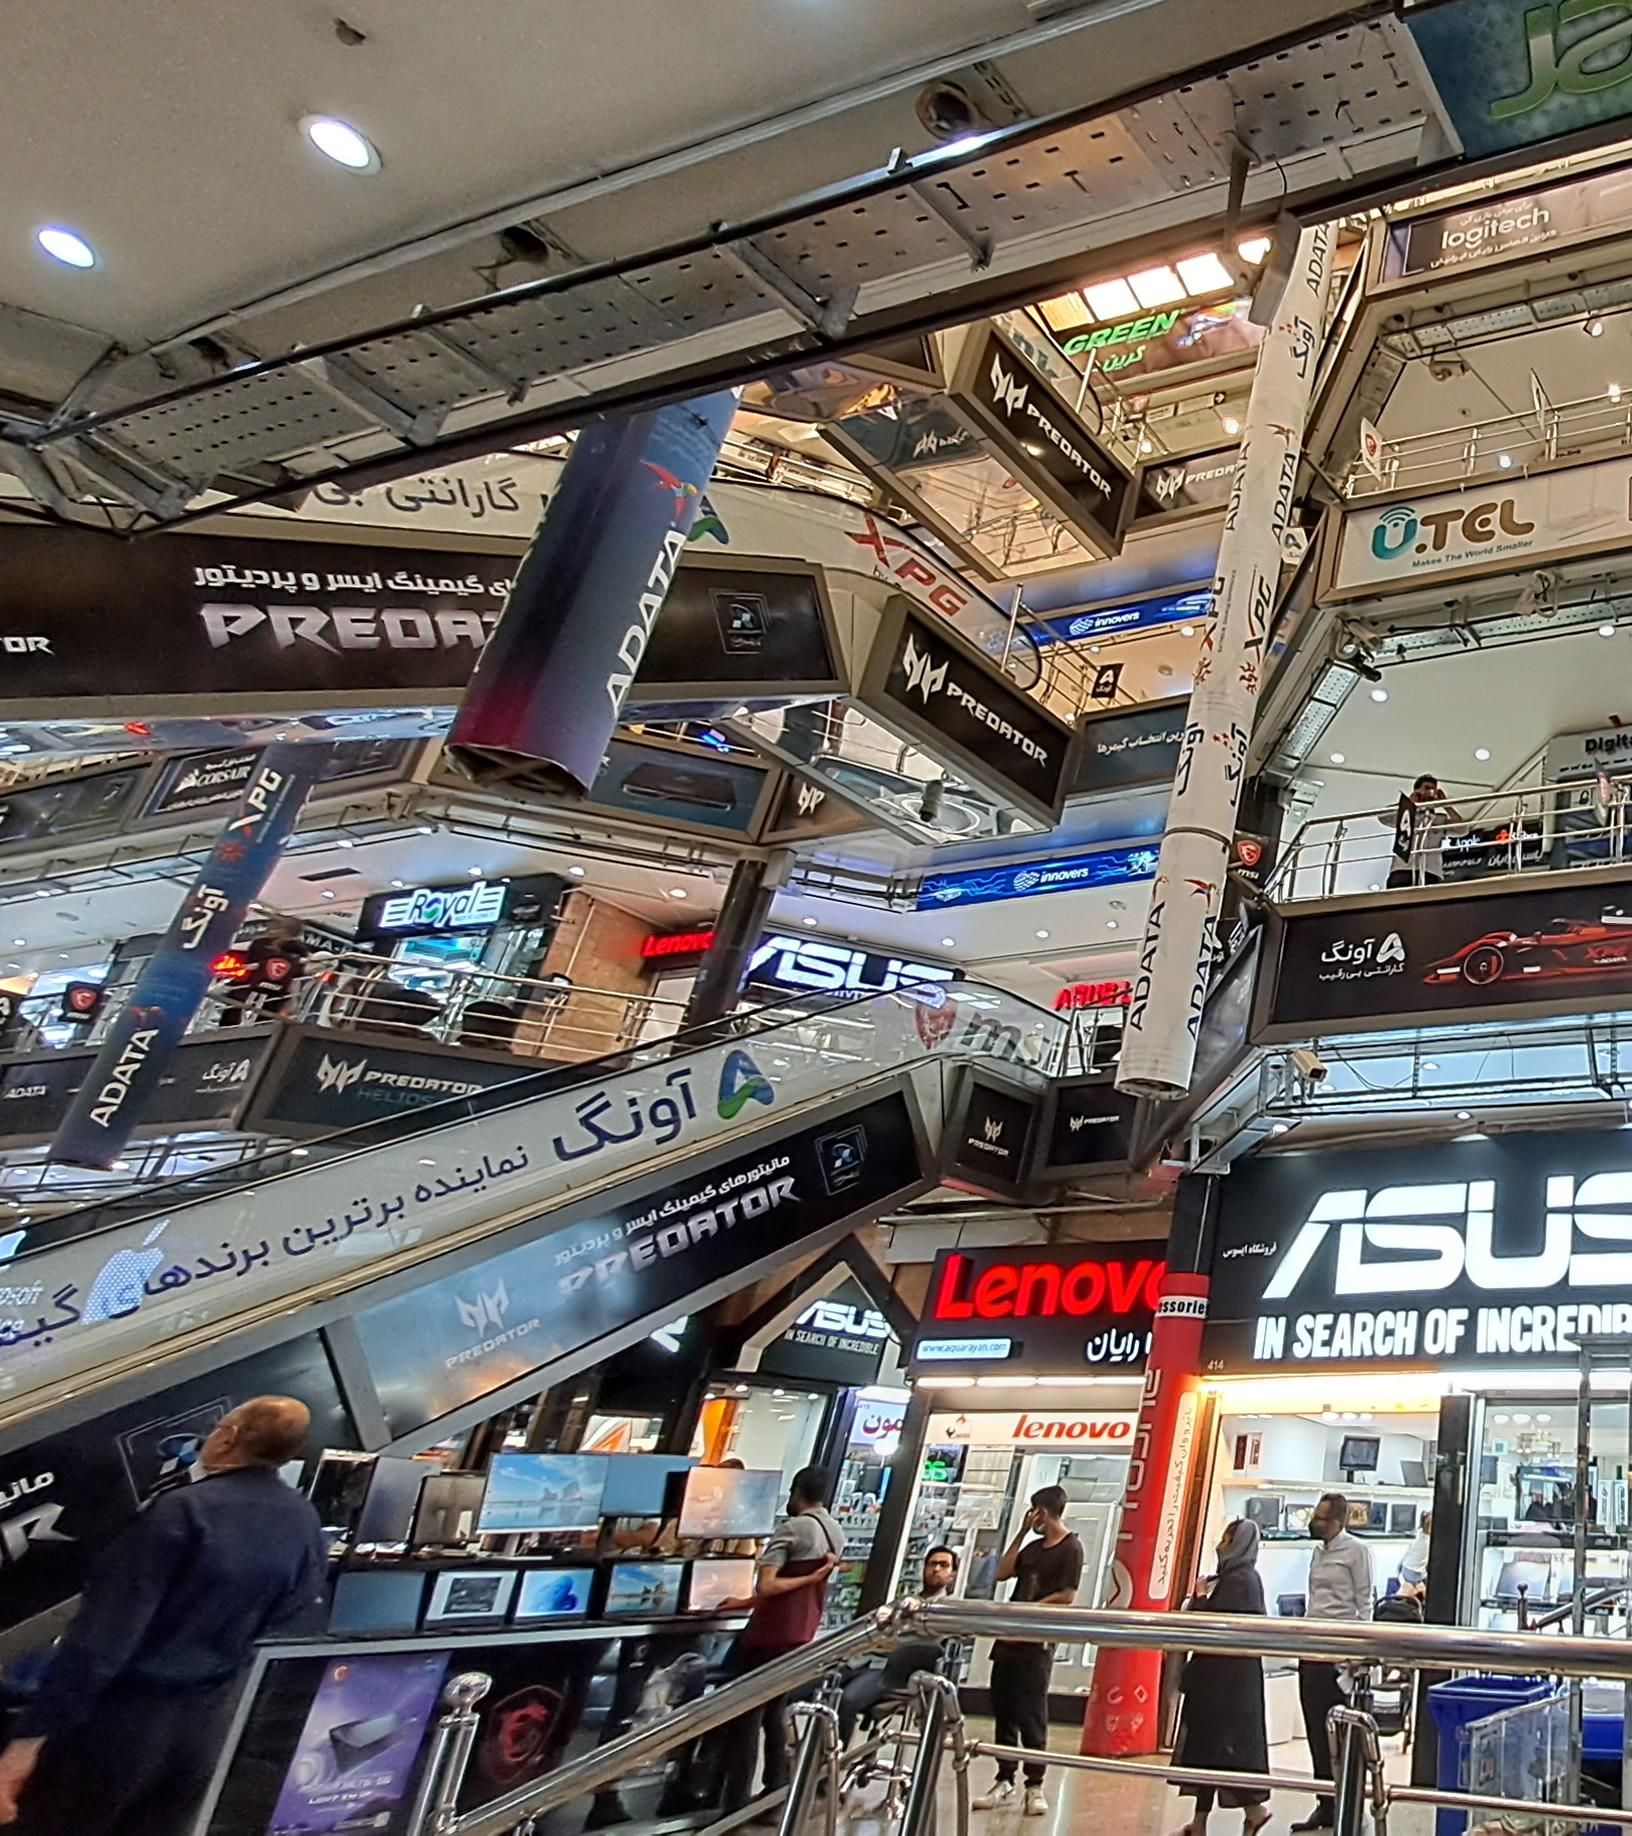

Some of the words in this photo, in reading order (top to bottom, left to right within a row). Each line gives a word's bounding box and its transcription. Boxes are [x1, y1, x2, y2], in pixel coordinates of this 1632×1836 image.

[1441, 207, 1550, 249] logitech
[1062, 309, 1181, 356] GREEN
[1026, 405, 1112, 501] PREDATOR
[386, 477, 520, 518] گارانتی
[1272, 448, 1297, 545] ADATA
[845, 512, 968, 616] XPG
[1412, 558, 1442, 568] Makes
[1445, 554, 1462, 562] The
[1465, 547, 1493, 559] World
[1495, 540, 1533, 553] Smaller
[195, 564, 297, 594] پردیتور
[302, 572, 320, 591] و
[326, 572, 383, 592] ایسر
[387, 573, 484, 597] گیمینگ
[607, 529, 687, 720] ADATA
[1094, 610, 1140, 629] innovers
[946, 685, 1049, 767] PREDATOR
[1455, 834, 1482, 852] Apple
[1041, 866, 1089, 883] innovers
[1238, 868, 1259, 880] msi
[408, 881, 487, 928] Royal
[740, 934, 957, 1008] ASUS
[1130, 901, 1166, 1031] ADATA
[1321, 937, 1377, 965] آونگ
[1362, 962, 1405, 978] گارانتی
[1187, 912, 1217, 1043] ADATA
[90, 1029, 159, 1128] ADATA
[363, 1072, 485, 1095] PREDATOR
[553, 1068, 699, 1162] آونگ
[1084, 1114, 1120, 1124] PREDATOR
[415, 1142, 529, 1203] نماینده
[718, 1155, 790, 1194] مانیتورهای
[659, 1183, 717, 1218] گیمینگ
[281, 1195, 405, 1257] برترین
[557, 1174, 804, 1295] PREDATOR
[625, 1208, 659, 1235] ایسر
[554, 1234, 611, 1267] پردیتور
[797, 1300, 899, 1342] ASUS
[1253, 1315, 1286, 1361] IN
[1292, 1309, 1419, 1359] SEARCH
[1424, 1307, 1467, 1354] OF
[444, 1317, 542, 1369] PREDATOR
[784, 1328, 796, 1344] IN
[796, 1331, 827, 1349] SEARCH
[828, 1335, 838, 1349] OF
[838, 1335, 880, 1356] INCREDIBLE
[1086, 1328, 1139, 1362] رایان
[1207, 1361, 1225, 1371] 414
[1012, 1414, 1131, 1439] lenovo
[1167, 1460, 1186, 1502] کیفیت
[0, 1502, 79, 1563] R
[1153, 1551, 1171, 1585] کنید
